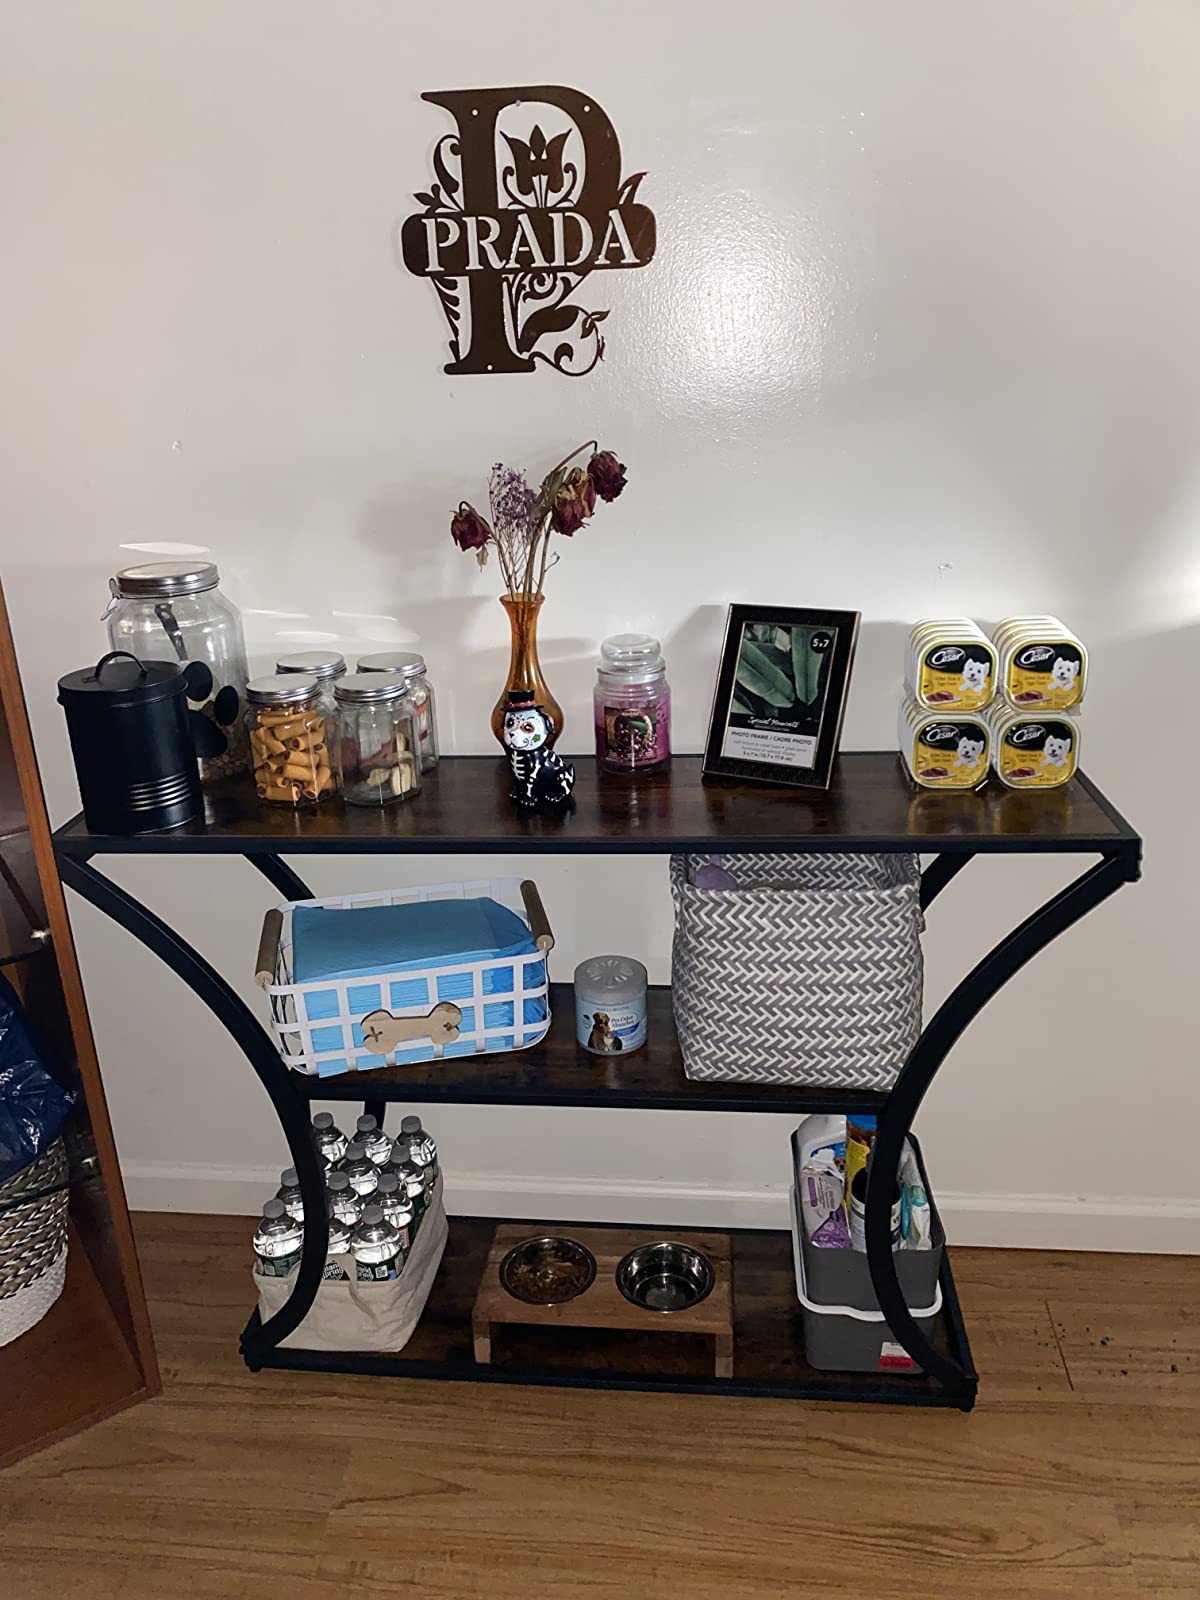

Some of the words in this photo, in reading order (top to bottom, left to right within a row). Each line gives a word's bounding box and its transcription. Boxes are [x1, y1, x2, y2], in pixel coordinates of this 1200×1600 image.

[421, 208, 641, 273] PRADA
[750, 733, 769, 741] FRAME
[792, 737, 813, 746] PHOTO
